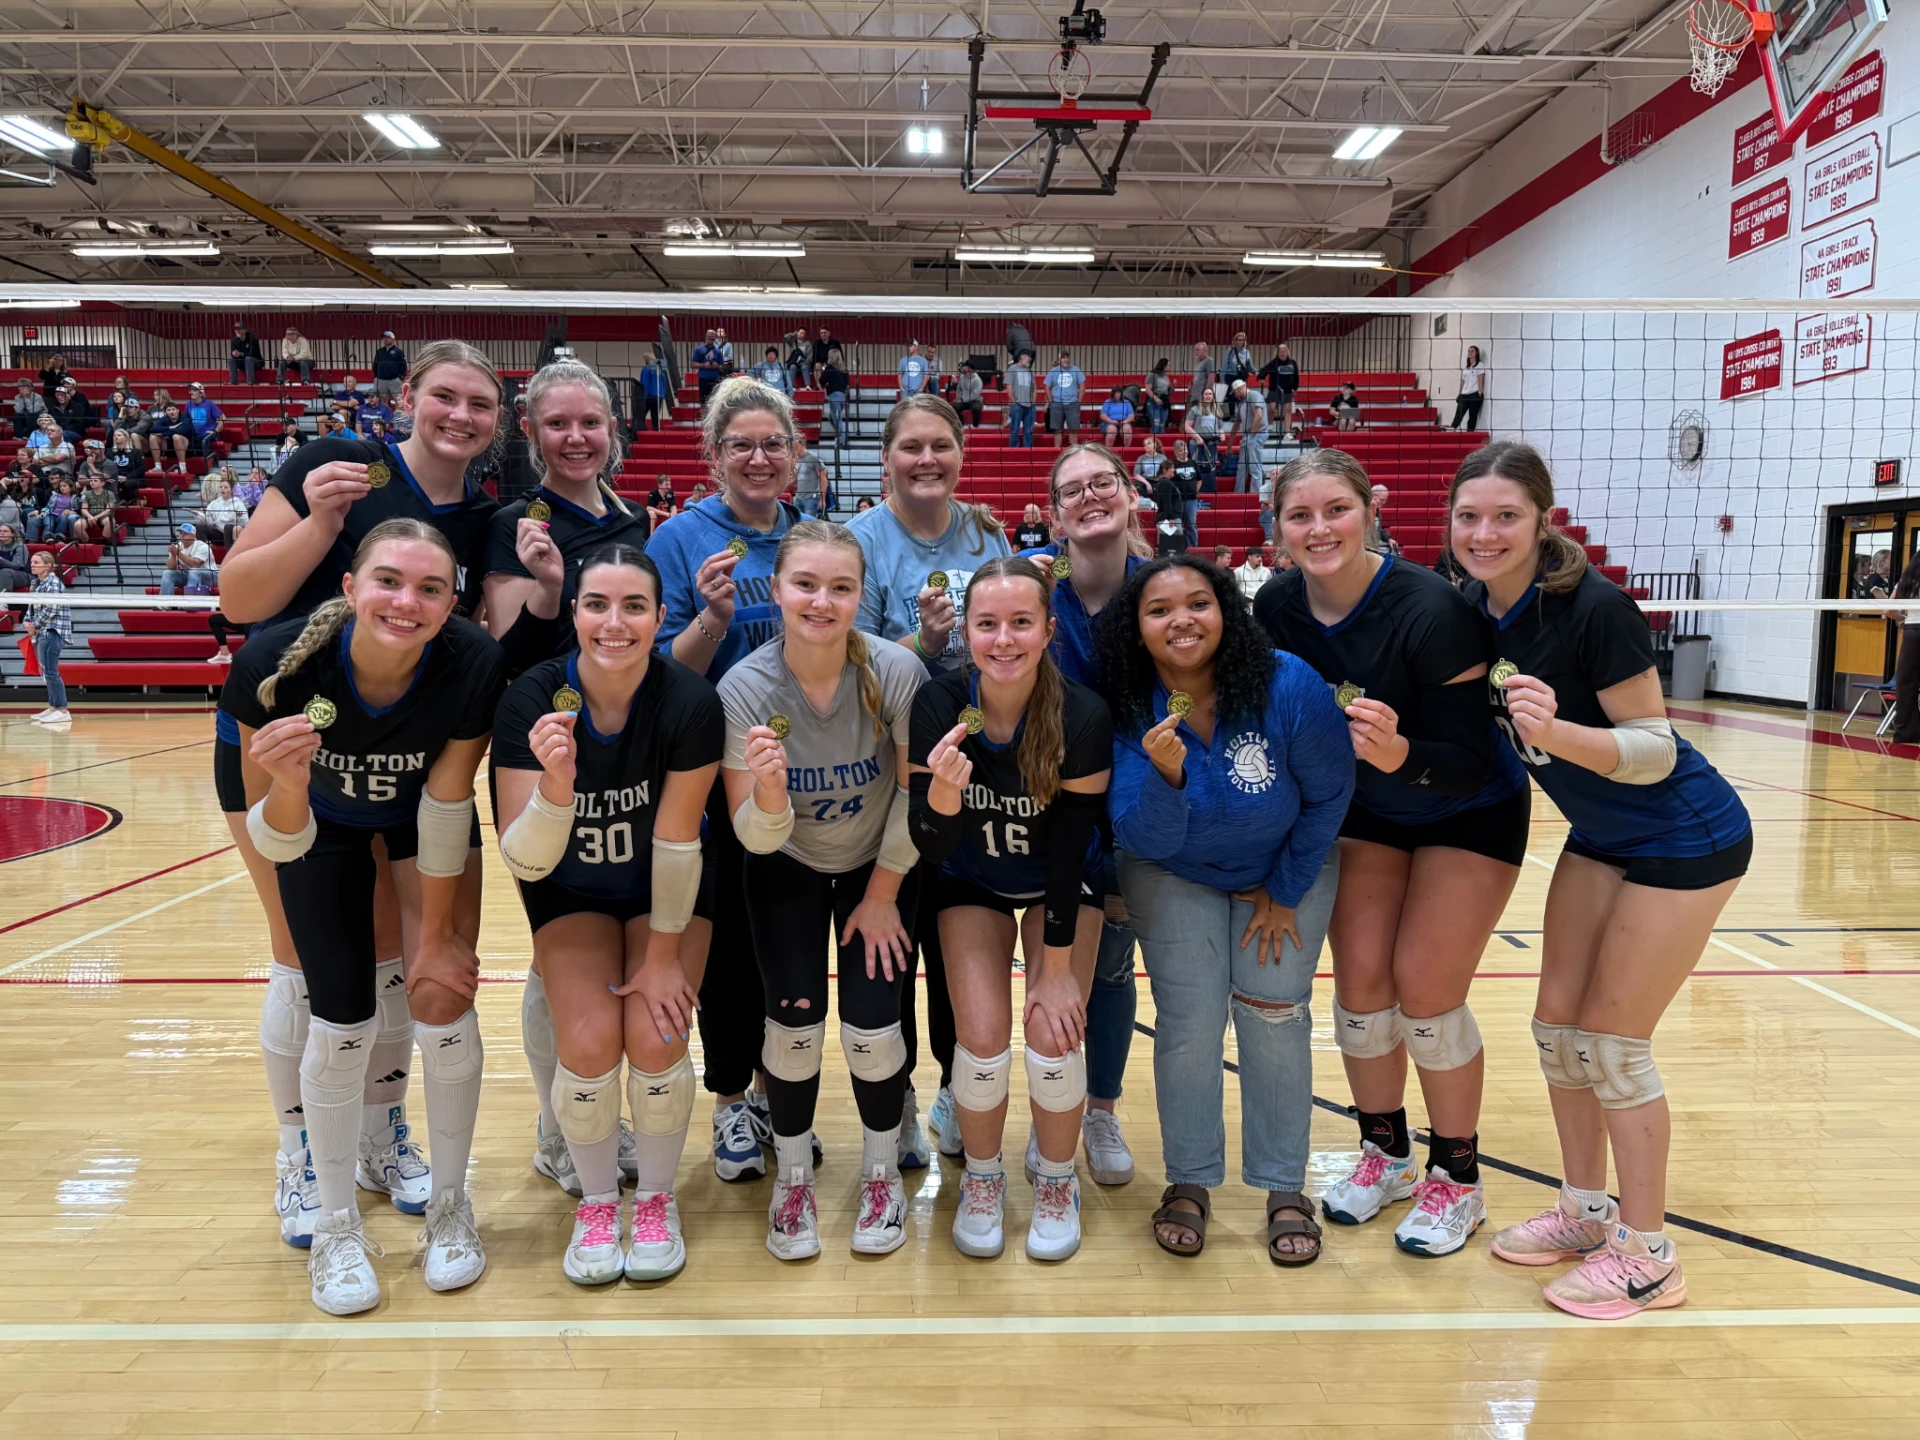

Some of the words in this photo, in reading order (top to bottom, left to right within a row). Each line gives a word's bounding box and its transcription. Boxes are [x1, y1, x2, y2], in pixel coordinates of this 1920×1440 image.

[1855, 59, 1879, 80] COUNTRY
[1835, 74, 1880, 111] CHAMPIONS
[1835, 108, 1853, 131] 1989
[1736, 143, 1755, 164] STATE
[1815, 169, 1822, 180] 4A
[1823, 162, 1837, 178] GIRLS
[1838, 146, 1870, 170] VOLLEYBALL
[1809, 180, 1829, 203] STATE
[1831, 160, 1873, 193] CHAMPIONS
[1830, 191, 1847, 213] 1989
[1733, 216, 1750, 237] STATE
[1751, 199, 1787, 228] CHAMPIONS
[1818, 248, 1824, 258] 4A
[1825, 242, 1840, 257] GIRLS
[1841, 235, 1859, 251] TRACK
[1805, 263, 1826, 284] STATE
[1826, 247, 1870, 276] CHAMPIONS
[1826, 276, 1842, 294] 1991
[1800, 340, 1821, 359] STATE
[1726, 361, 1741, 379] STATE
[1741, 351, 1780, 373] CHAMPIONS
[1741, 374, 1756, 391] 1984
[1878, 463, 1895, 483] EXIT
[1224, 731, 1269, 760] HOLTON
[311, 748, 426, 772] HOLTON
[786, 754, 881, 793] HOLTON
[339, 772, 398, 801] 15
[575, 780, 650, 818] OLTON
[576, 821, 634, 864] 30
[982, 820, 1030, 858] 16
